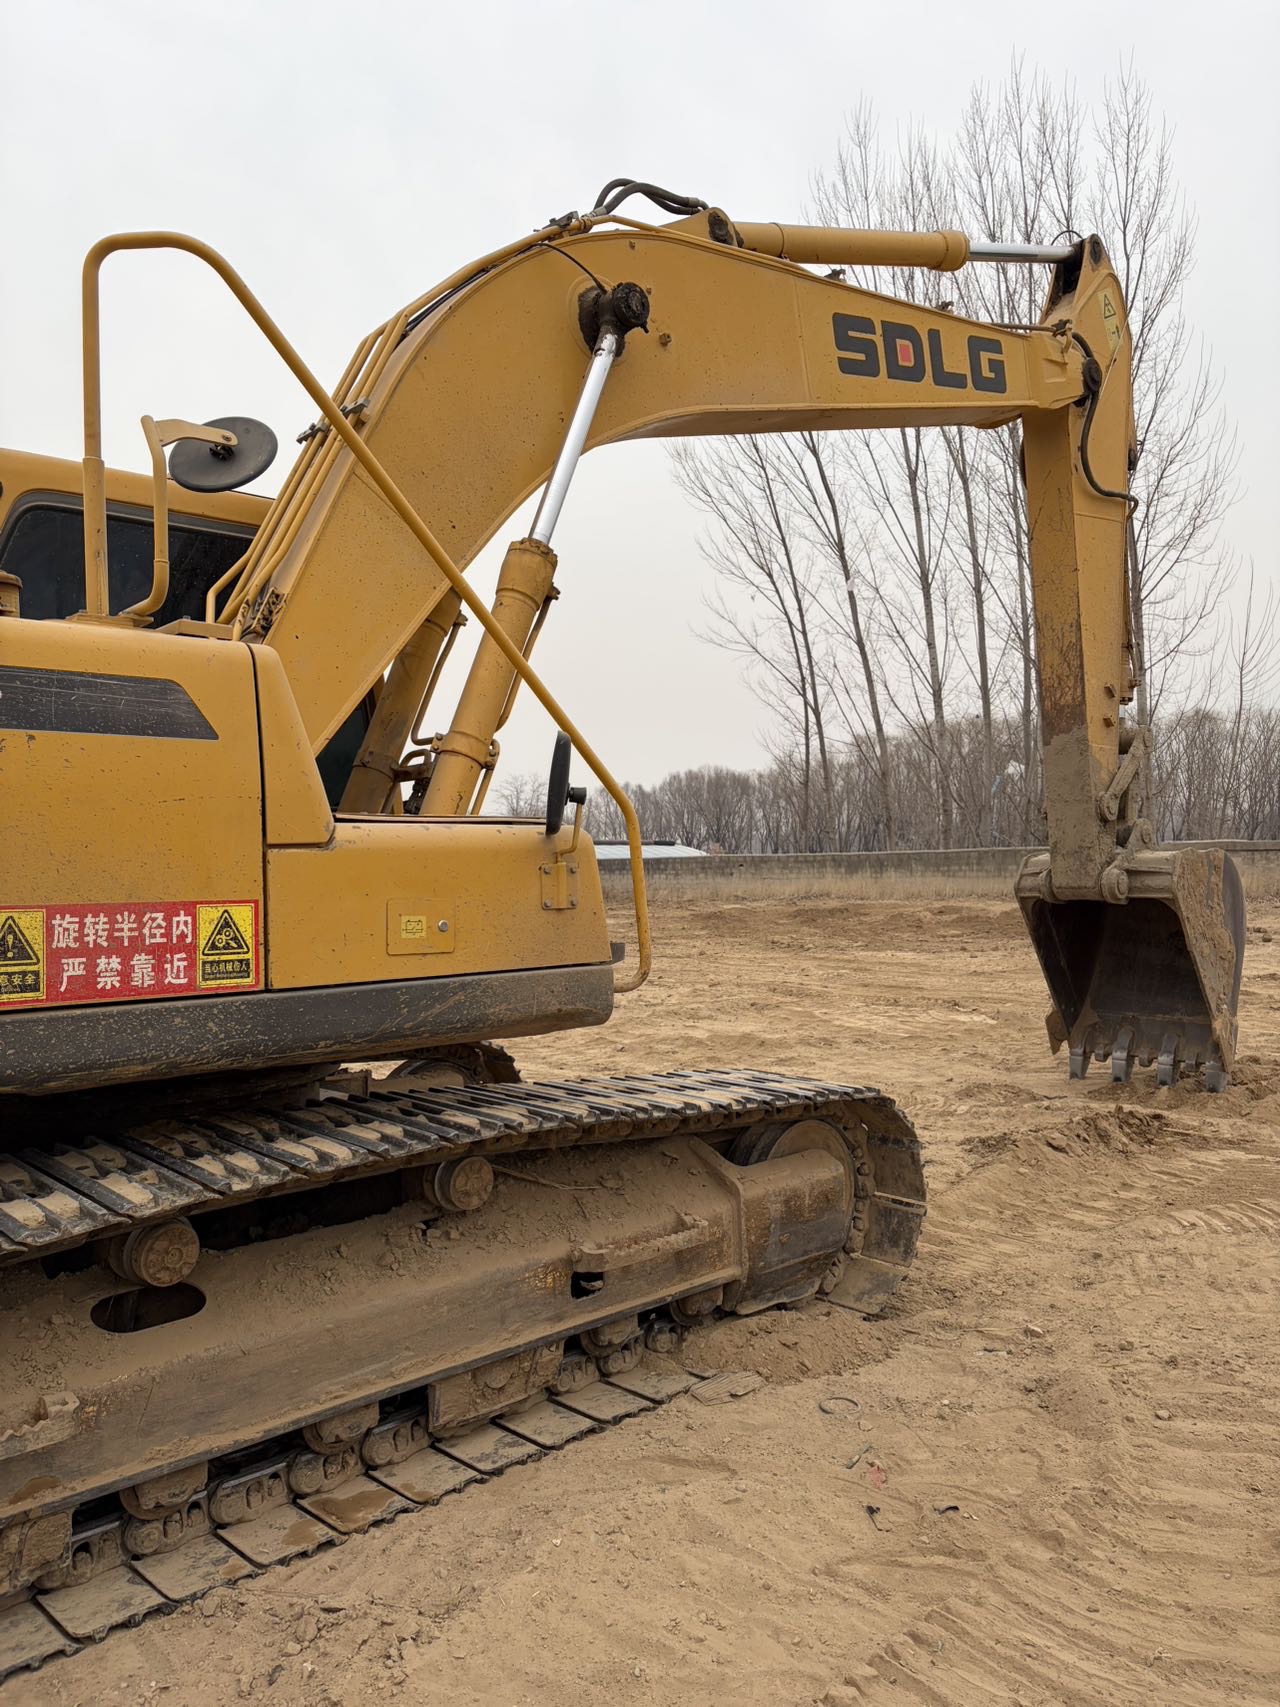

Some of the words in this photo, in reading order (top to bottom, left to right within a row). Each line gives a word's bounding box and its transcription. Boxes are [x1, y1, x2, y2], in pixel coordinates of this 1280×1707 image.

[832, 312, 1007, 394] SDLG
[51, 910, 193, 949] 旋转半径内
[60, 952, 189, 992] 严禁靠近
